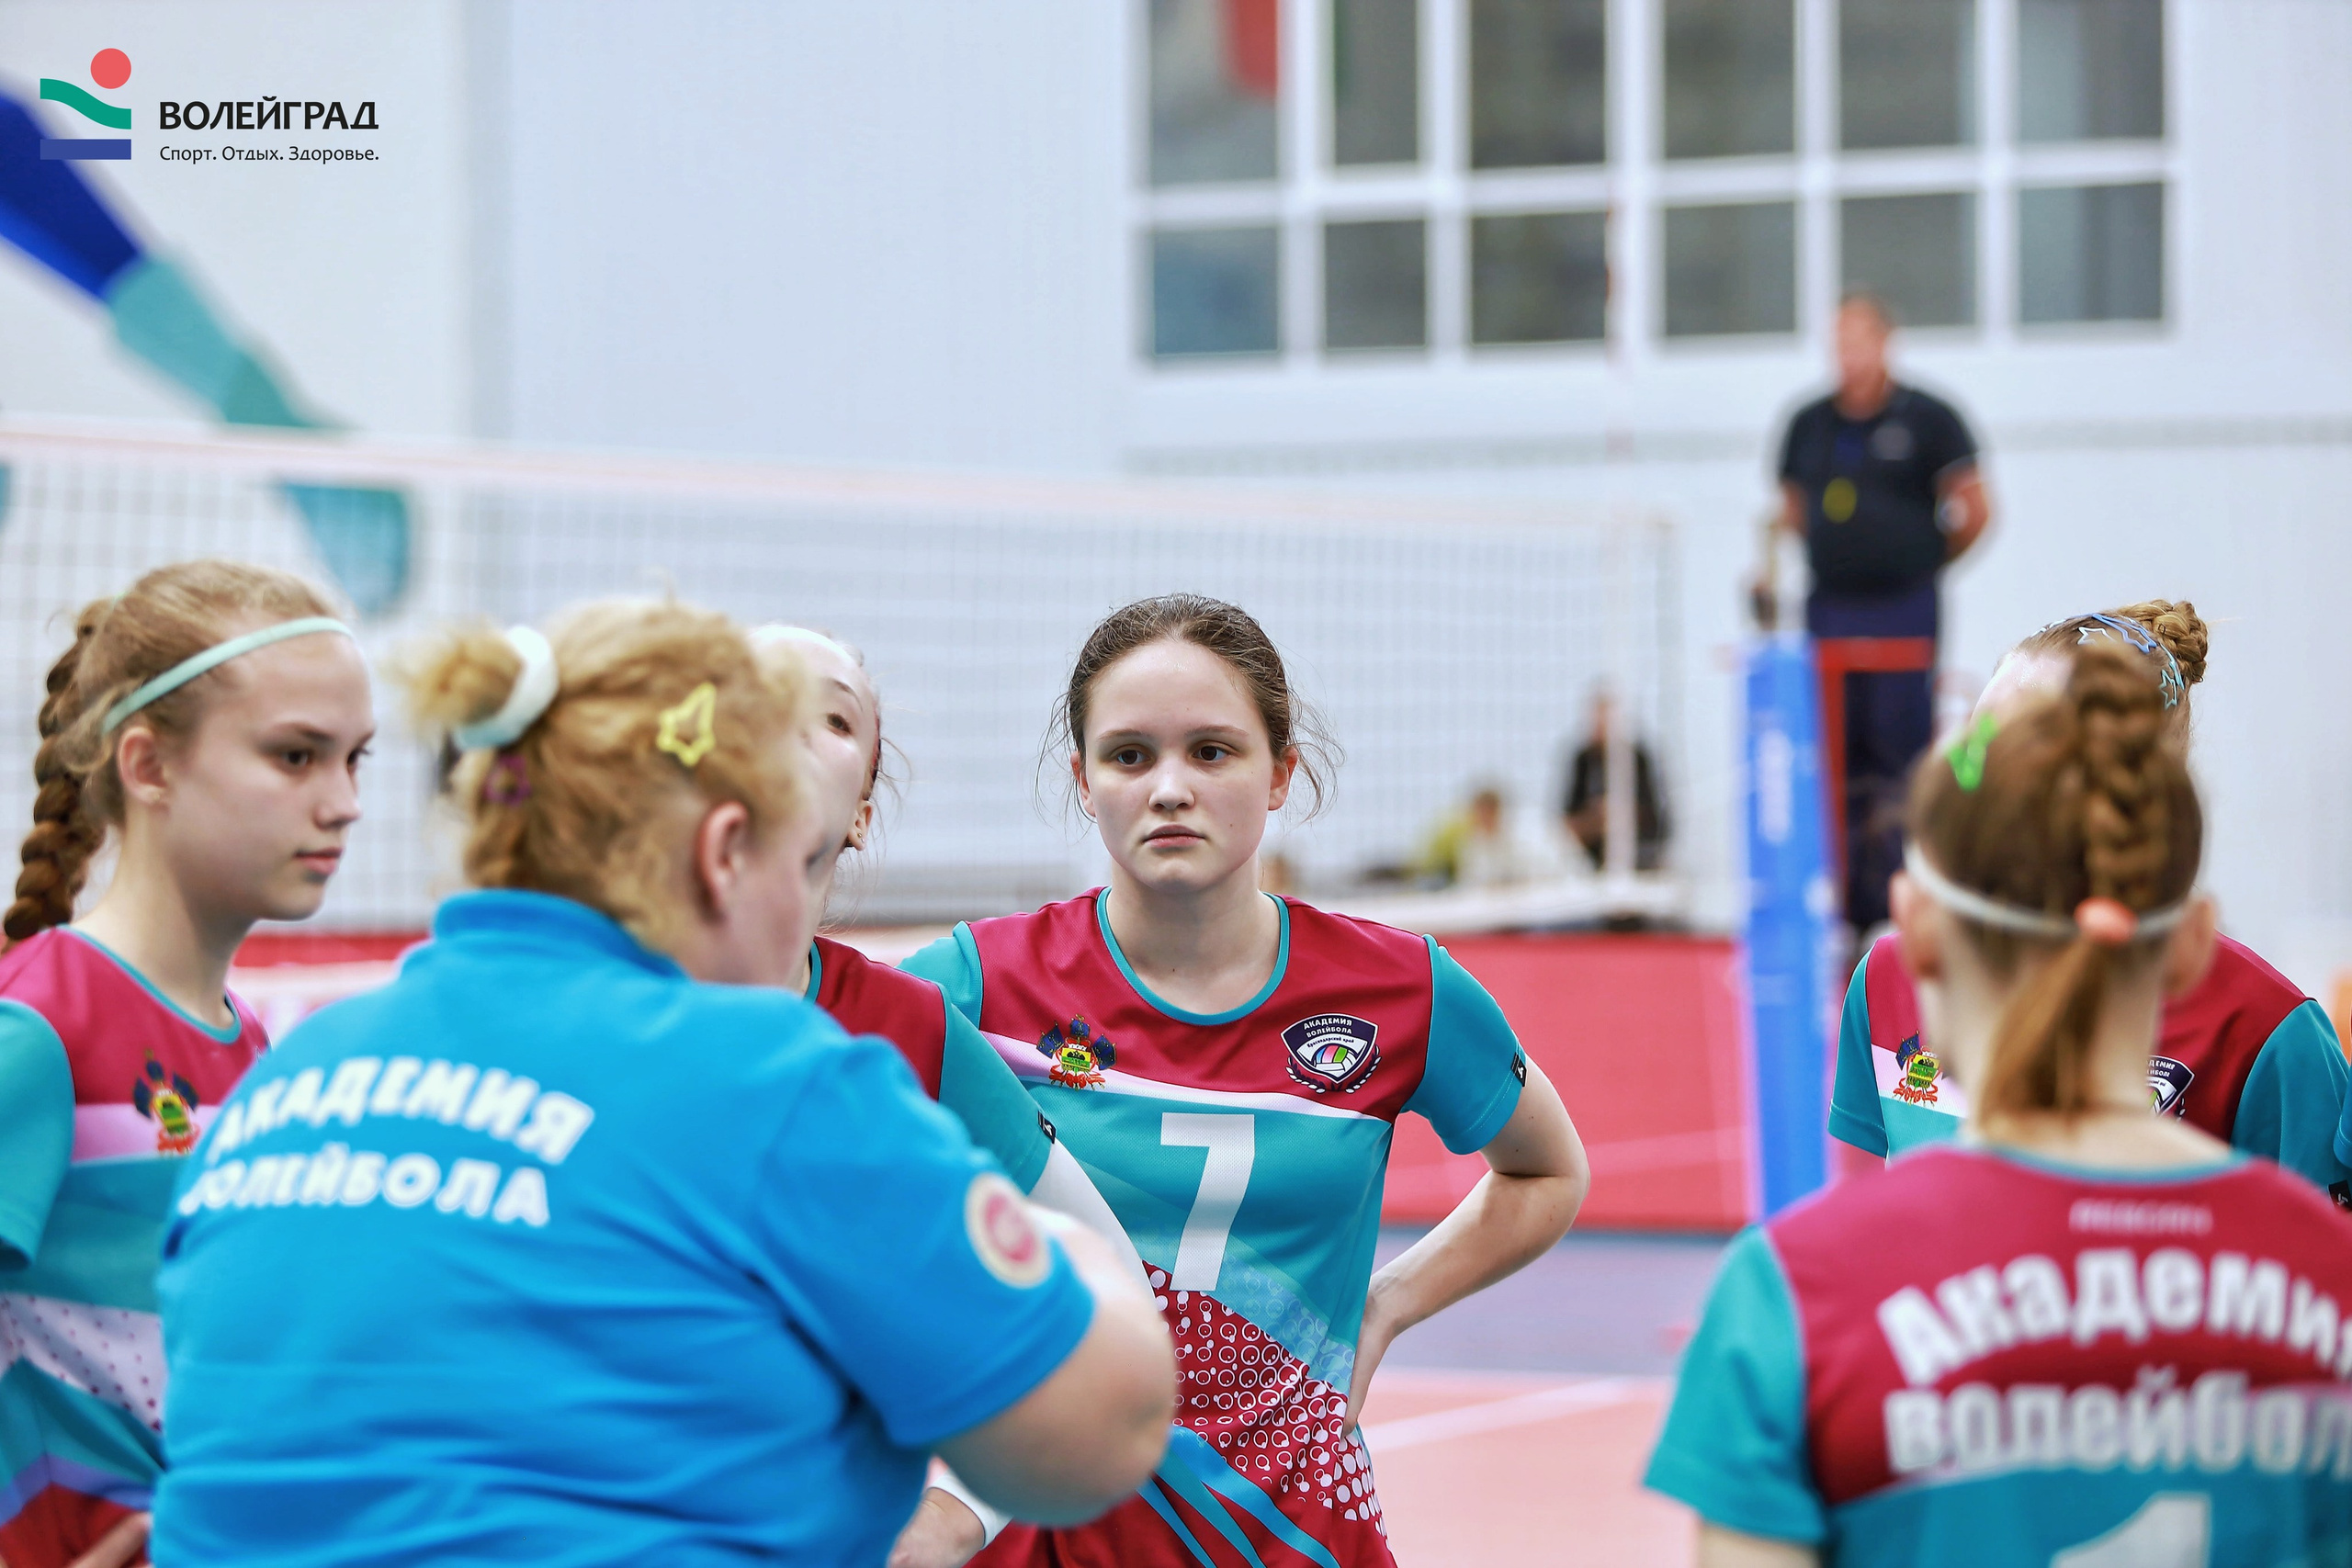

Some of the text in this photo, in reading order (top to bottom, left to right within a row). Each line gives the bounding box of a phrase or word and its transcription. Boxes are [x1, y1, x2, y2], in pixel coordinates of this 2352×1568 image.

[1304, 1017, 1352, 1030] АКАДЕМИЯ
[1306, 1025, 1352, 1038] ВОЛЕЙБОЛА
[1160, 1111, 1255, 1292] 7
